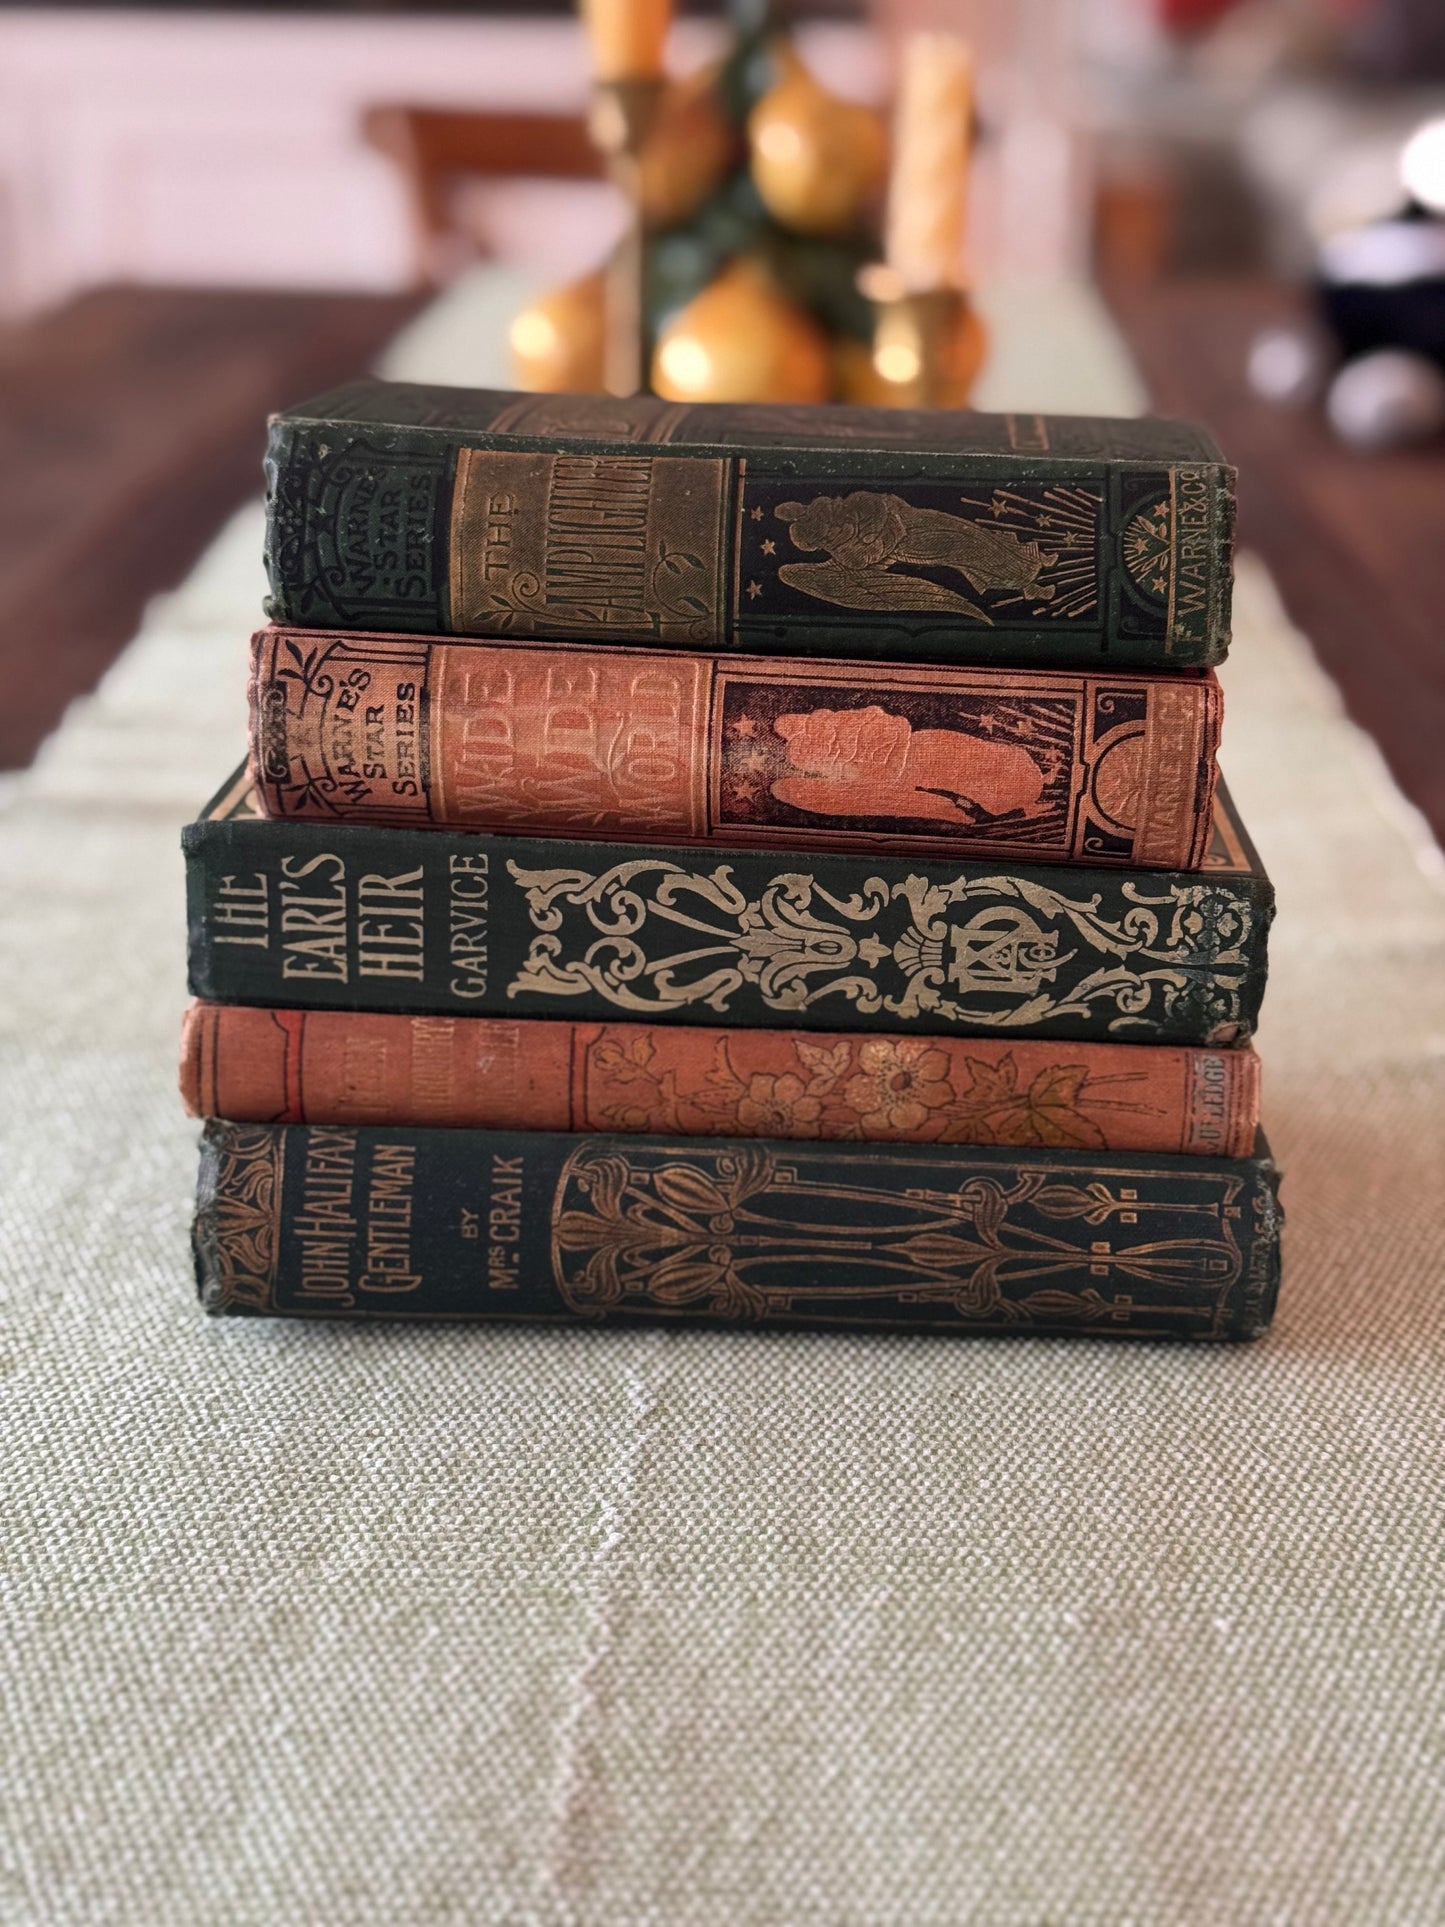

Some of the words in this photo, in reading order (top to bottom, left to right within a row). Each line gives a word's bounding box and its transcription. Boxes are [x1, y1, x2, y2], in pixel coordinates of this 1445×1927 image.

[373, 490, 402, 571] STAR
[394, 475, 432, 598] SERIES
[484, 493, 514, 582] THE
[533, 455, 661, 638] LAMPLIGHTER
[332, 667, 374, 803] WARNE'S
[362, 703, 388, 779] STAR
[391, 682, 419, 797] SERIES
[455, 668, 515, 815] WIDE
[535, 666, 600, 810] WIDE
[617, 670, 687, 829] WORLD
[278, 852, 349, 985] EARL'S
[356, 864, 425, 983] HEIR
[449, 852, 490, 999] GARVICE
[292, 1126, 359, 1239] HALIFAX
[356, 1143, 424, 1294] GENTLEMAN
[460, 1206, 481, 1251] BY
[487, 1153, 525, 1254] CRAIK
[292, 1240, 358, 1309] JOHN
